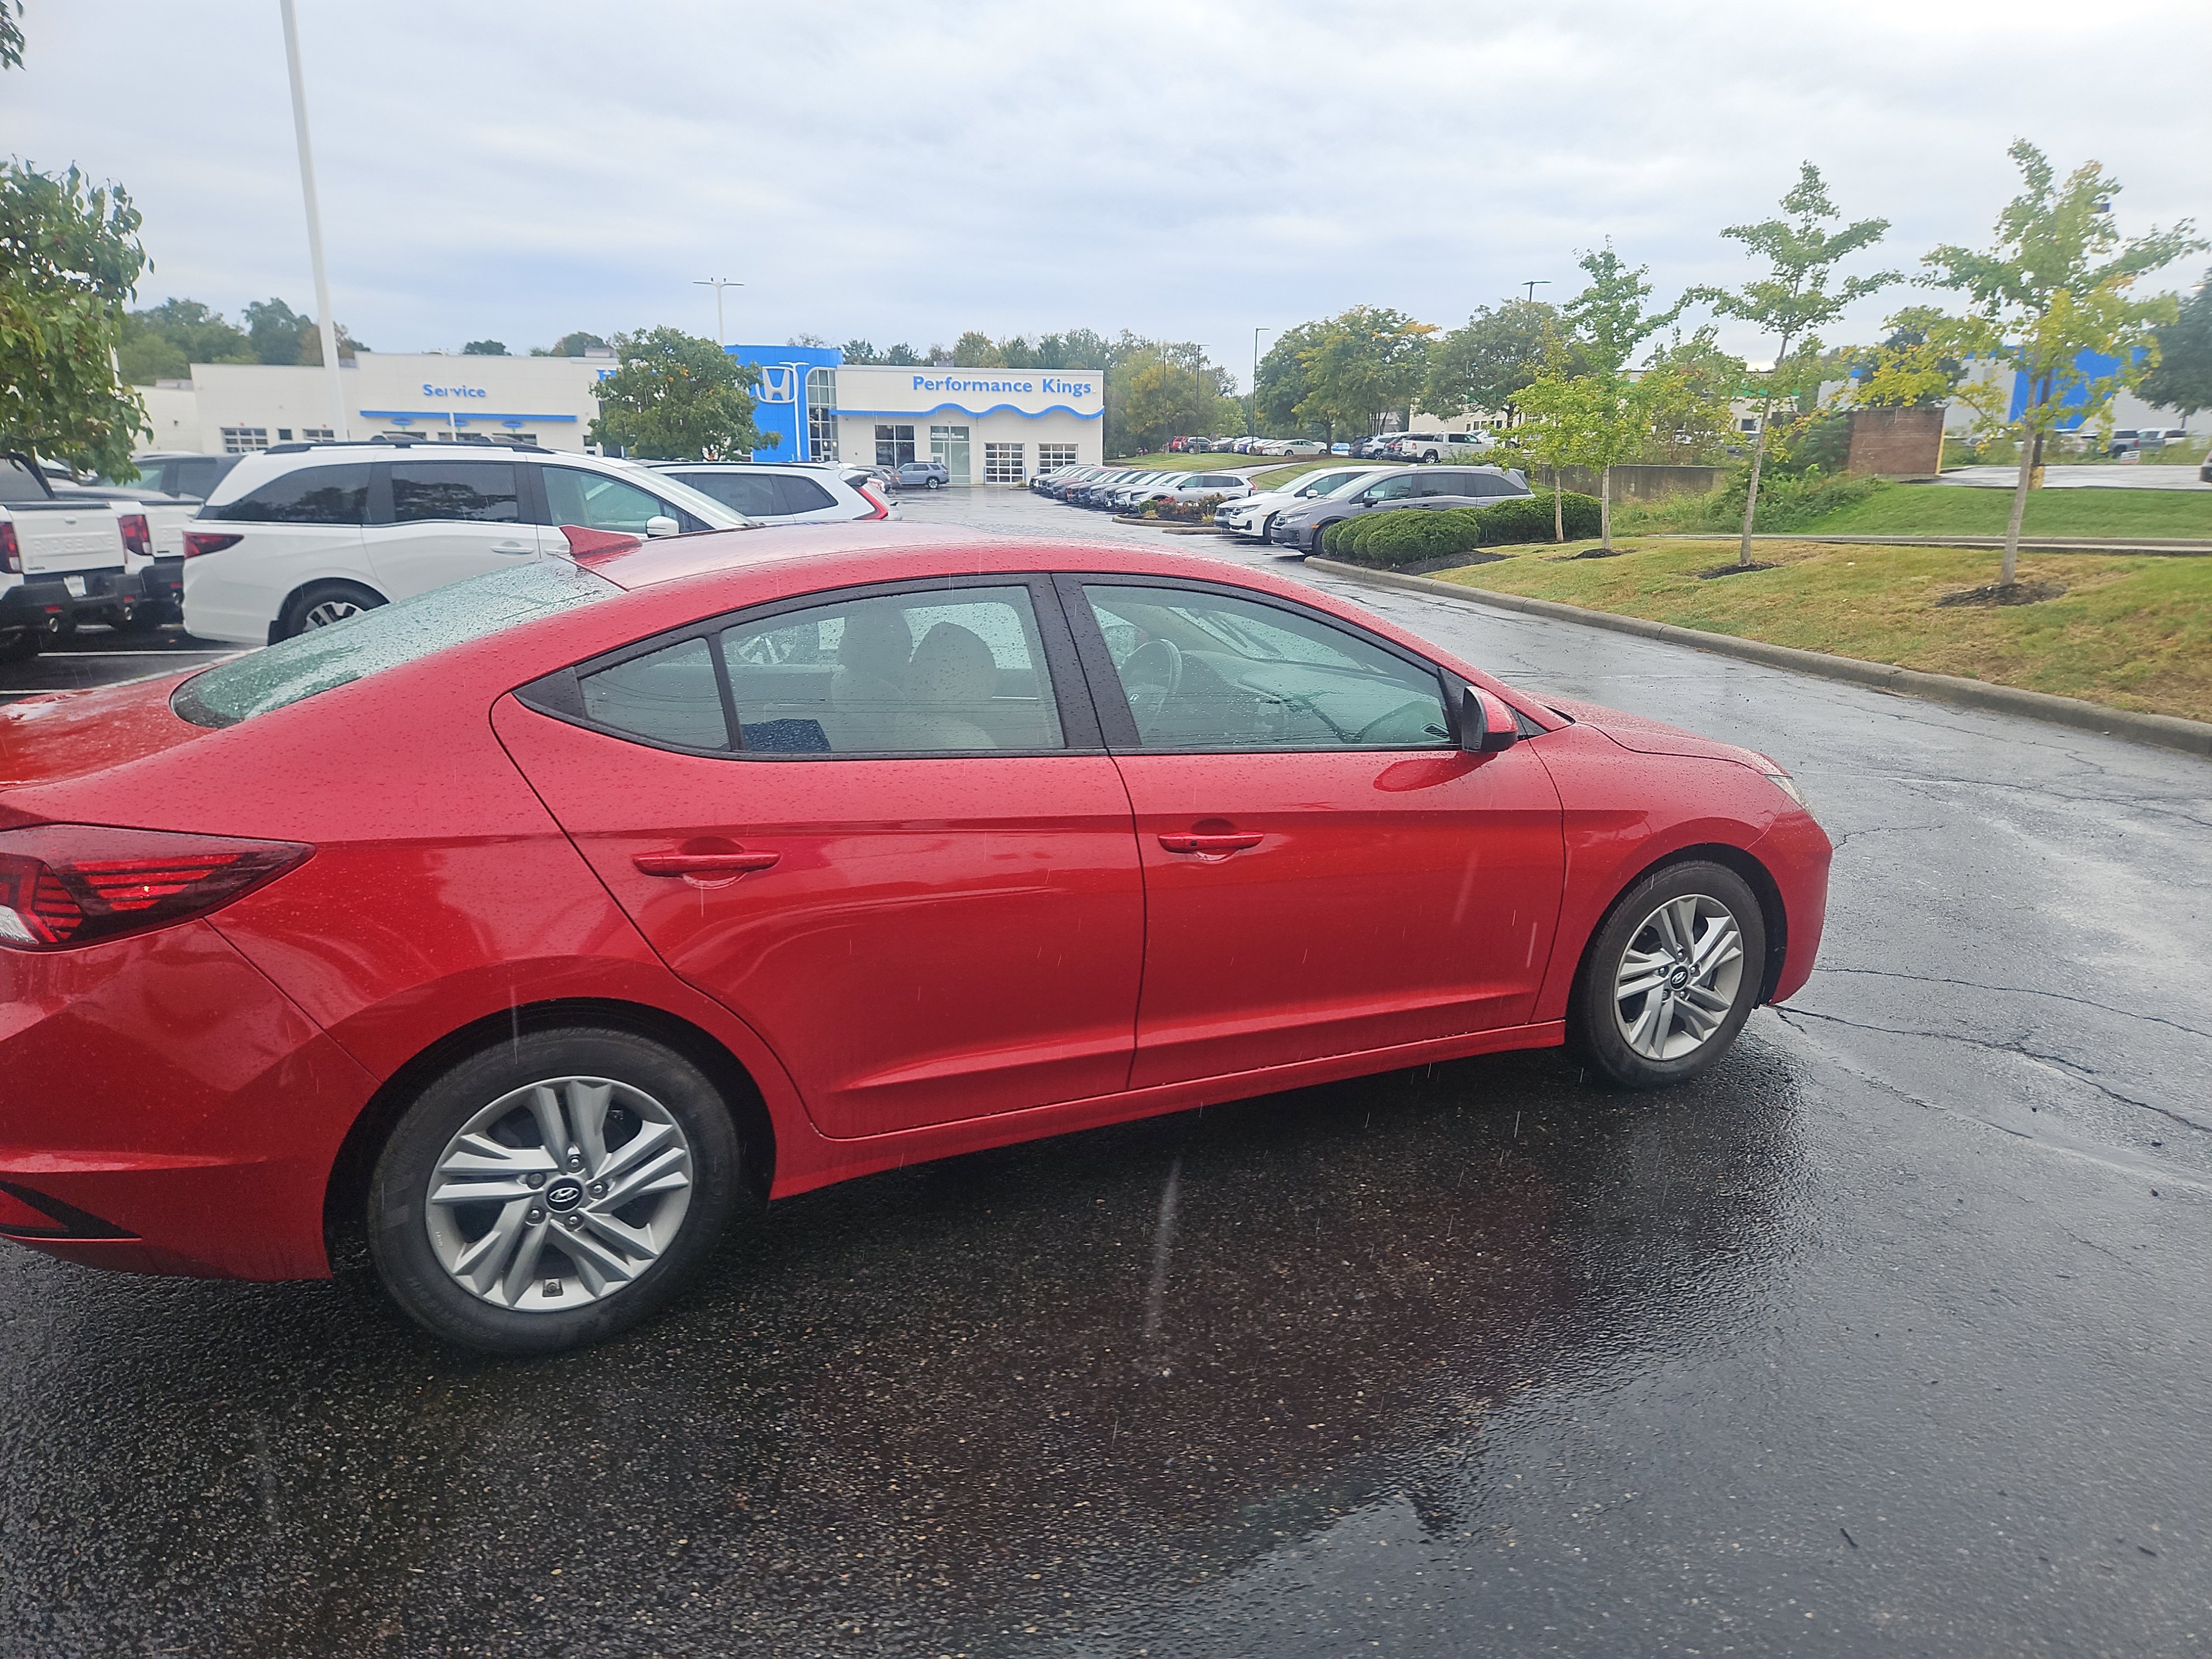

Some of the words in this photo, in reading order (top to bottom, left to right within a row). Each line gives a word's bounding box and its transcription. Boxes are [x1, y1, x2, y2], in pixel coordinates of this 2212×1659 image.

[422, 383, 487, 398] Service
[912, 375, 1033, 392] Performance
[1042, 378, 1091, 397] Kings
